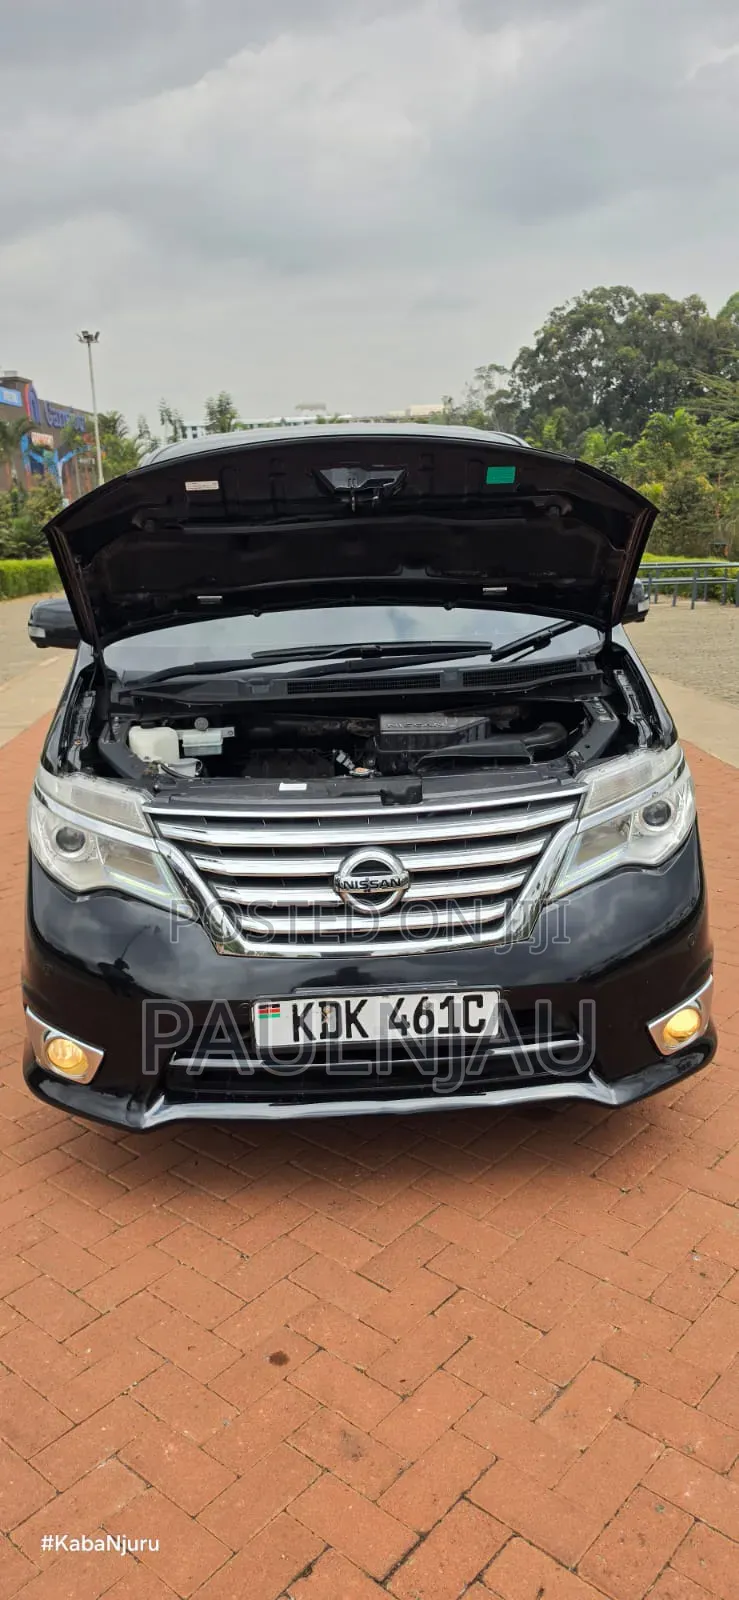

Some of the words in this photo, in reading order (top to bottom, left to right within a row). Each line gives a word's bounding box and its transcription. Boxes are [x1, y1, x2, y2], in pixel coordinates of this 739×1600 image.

[343, 879, 401, 889] NISSAN
[292, 999, 369, 1042] KDK
[389, 994, 486, 1036] 461C
